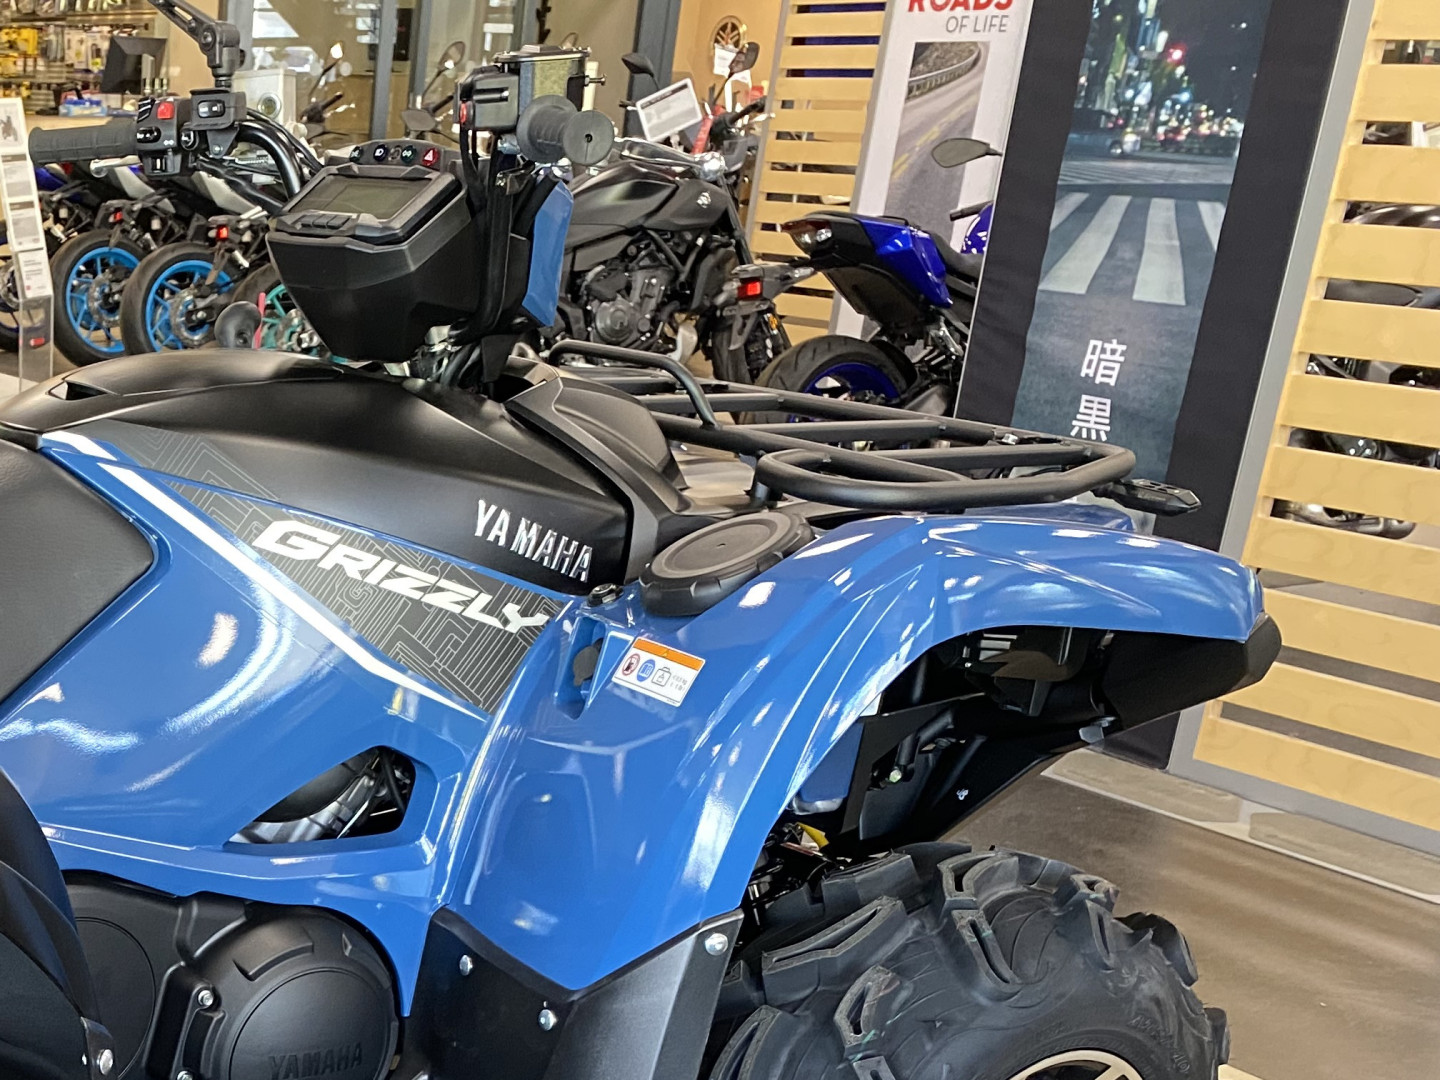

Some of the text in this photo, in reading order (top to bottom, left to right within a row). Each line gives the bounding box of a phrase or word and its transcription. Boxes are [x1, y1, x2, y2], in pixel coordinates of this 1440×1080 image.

[945, 14, 1010, 34] OF LIFE
[1070, 339, 1127, 442] 暗黒
[252, 519, 549, 634] GRIZZLY
[472, 498, 593, 582] YAMAHA
